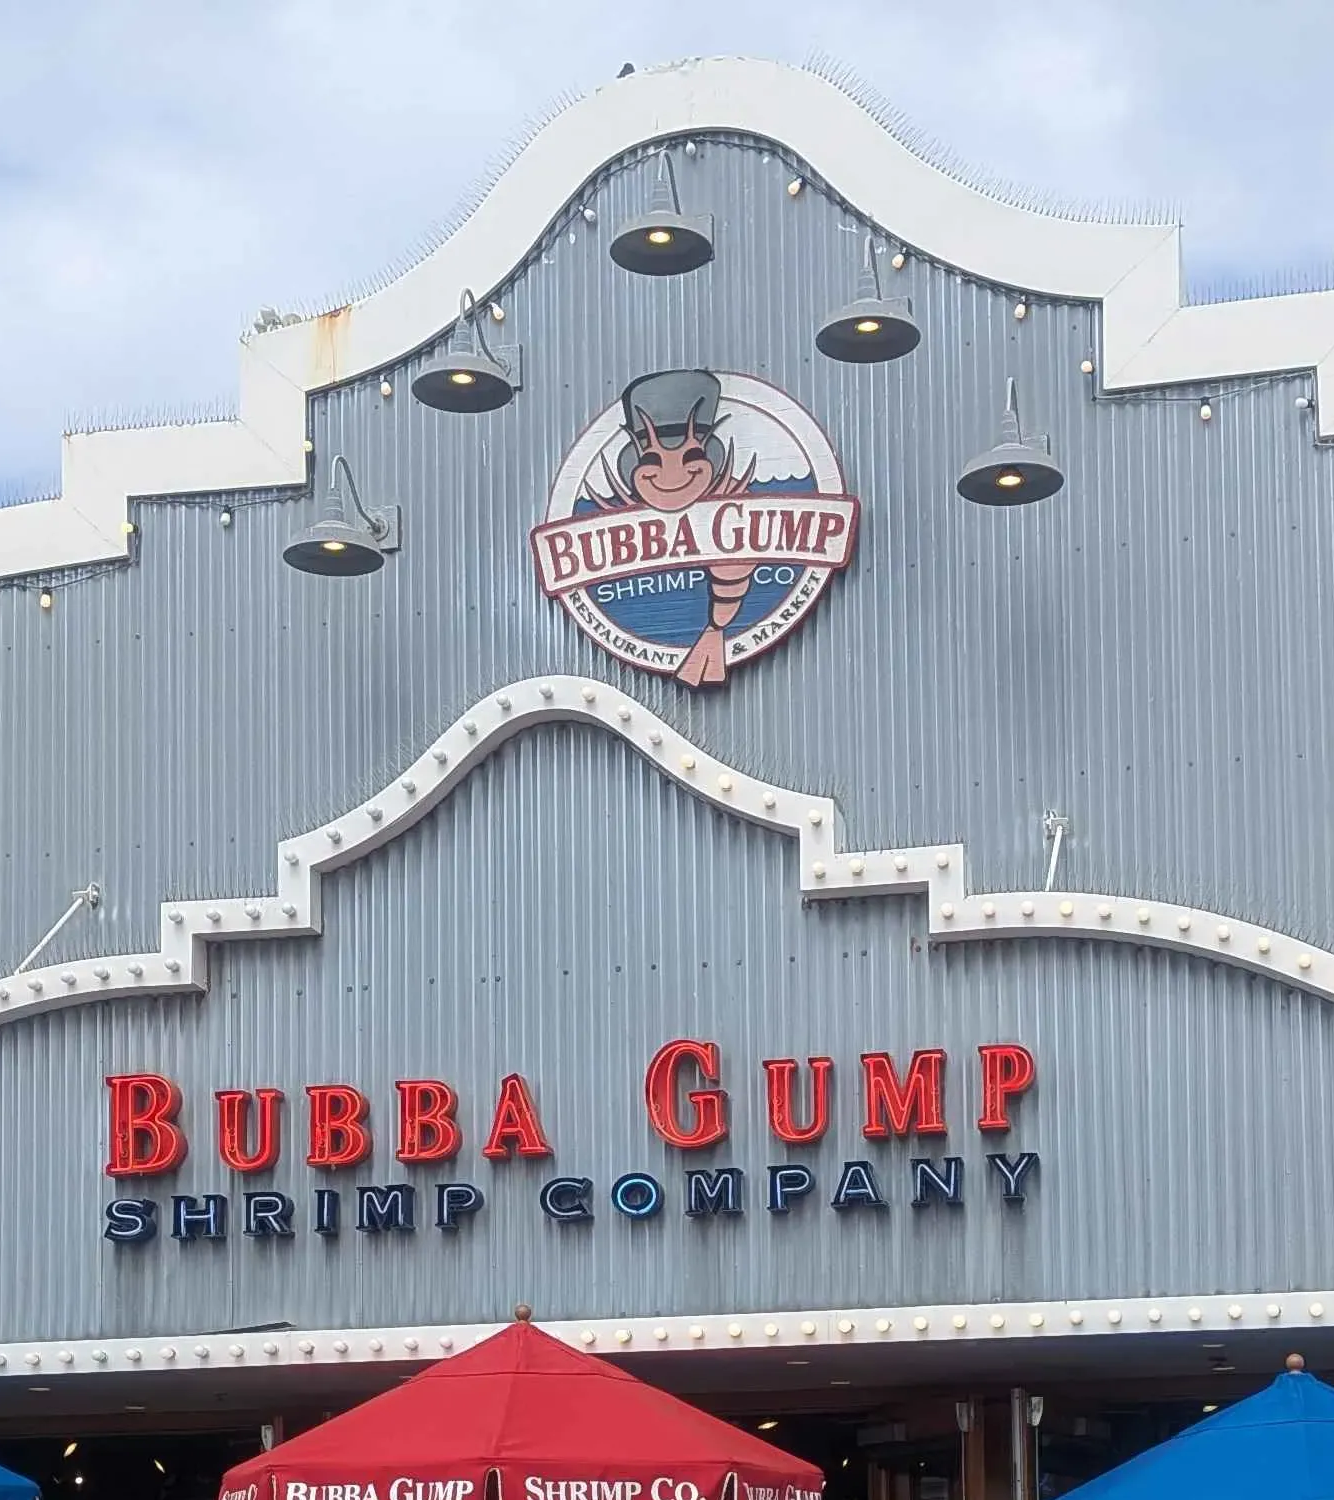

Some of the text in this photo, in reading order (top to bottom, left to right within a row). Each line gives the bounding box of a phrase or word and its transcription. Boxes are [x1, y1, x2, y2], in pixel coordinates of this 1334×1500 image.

[544, 502, 846, 583] BUBBA GUMP
[597, 566, 795, 603] SHRIMP CO
[568, 570, 823, 666] RESTAURANT & MARKET
[105, 1038, 1037, 1177] BUBBA GUMP
[105, 1151, 1040, 1243] SHRIMP COMPANY
